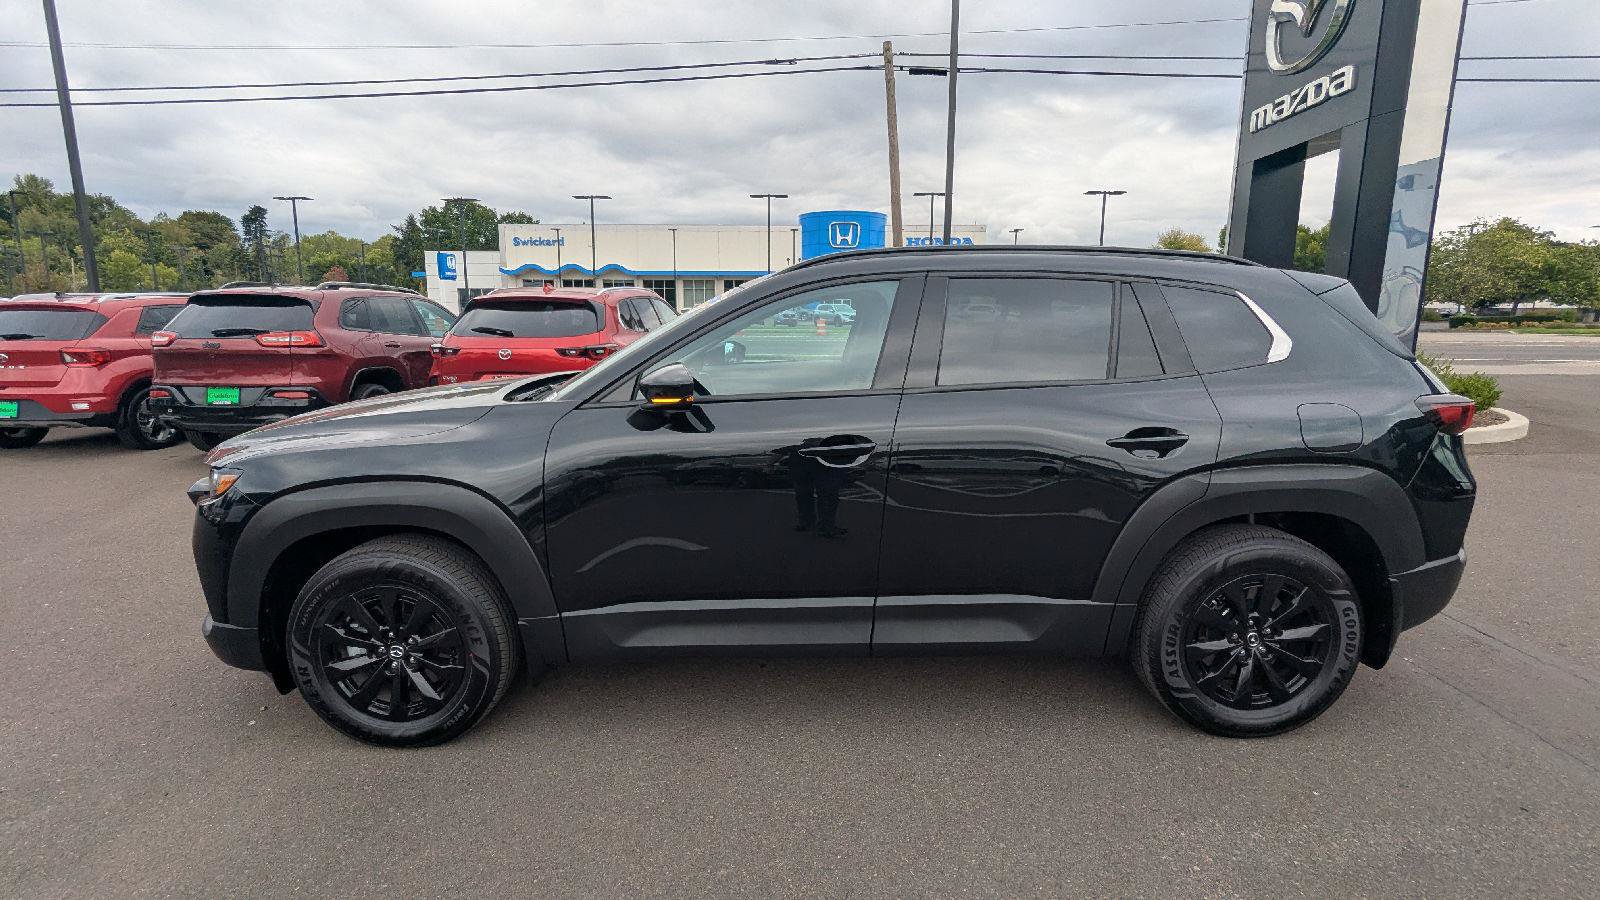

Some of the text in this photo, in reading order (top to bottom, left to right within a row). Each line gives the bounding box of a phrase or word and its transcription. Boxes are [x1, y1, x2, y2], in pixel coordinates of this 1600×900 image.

[512, 236, 565, 247] Swickard
[905, 236, 975, 246] HONDA
[1166, 611, 1184, 679] ASSURA
